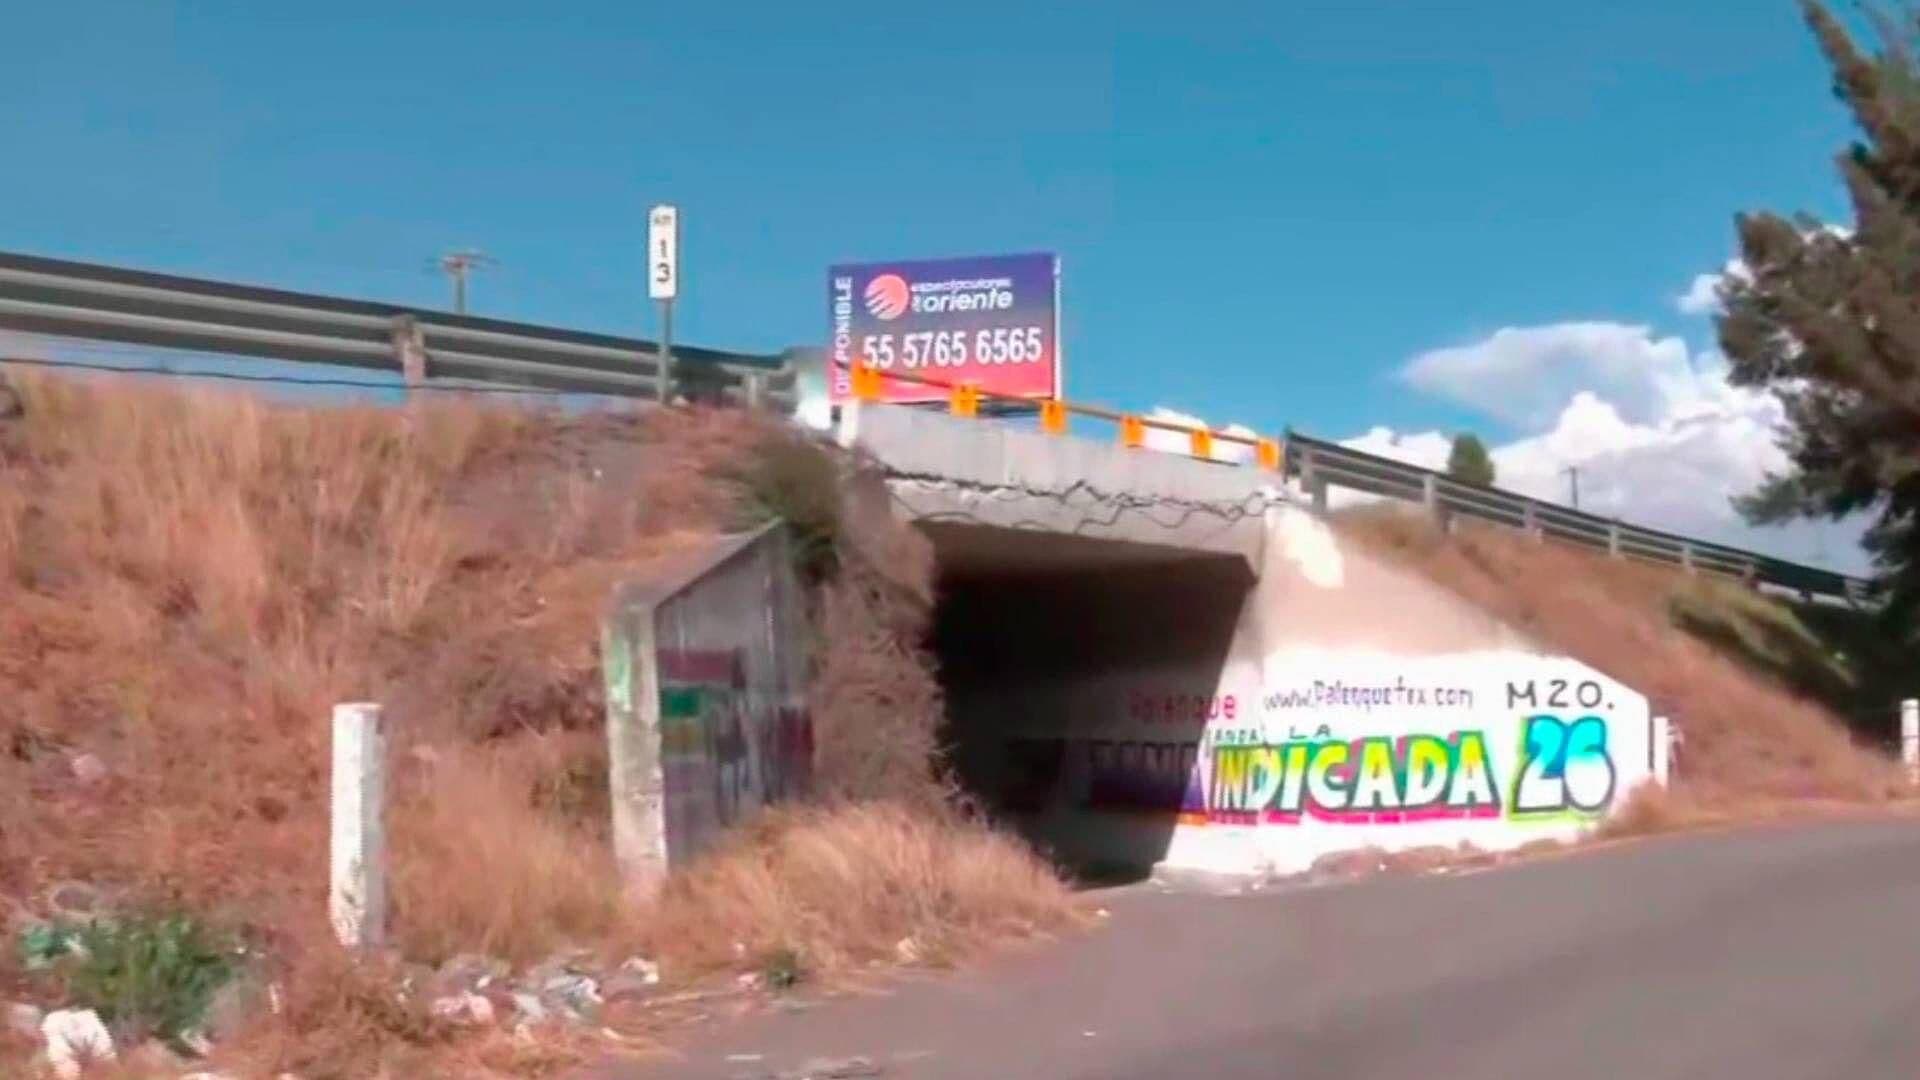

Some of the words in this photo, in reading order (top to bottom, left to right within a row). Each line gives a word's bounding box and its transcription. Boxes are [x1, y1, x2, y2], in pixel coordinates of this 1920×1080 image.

[922, 288, 1014, 313] oriente
[863, 334, 895, 369] 55
[902, 331, 967, 368] 5765
[975, 326, 1042, 366] 6565
[1207, 731, 1502, 822] INDICADA
[1509, 714, 1617, 816] 26
